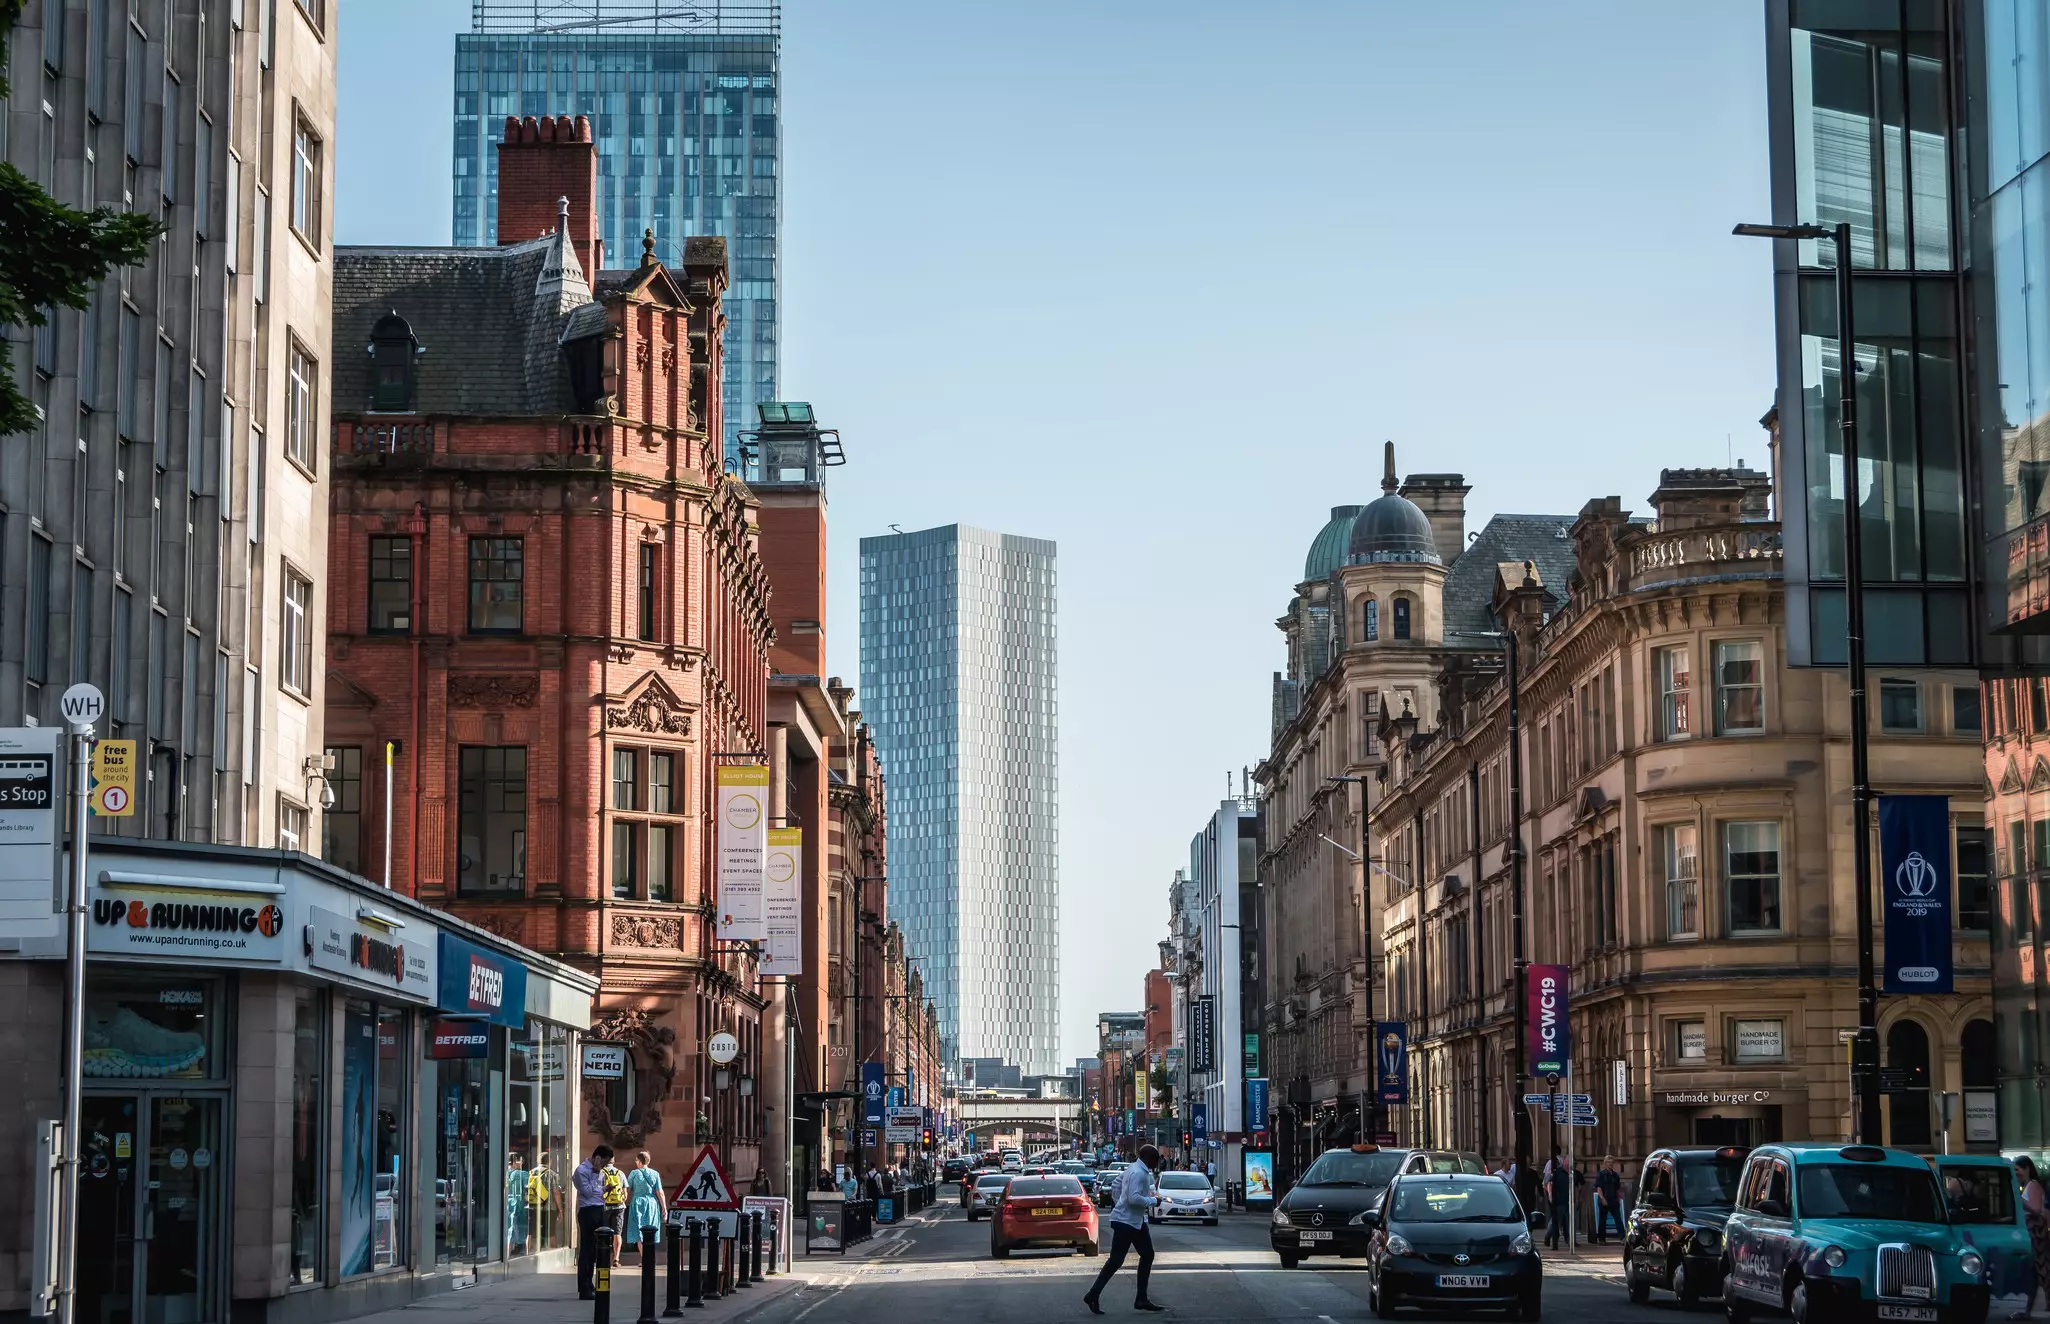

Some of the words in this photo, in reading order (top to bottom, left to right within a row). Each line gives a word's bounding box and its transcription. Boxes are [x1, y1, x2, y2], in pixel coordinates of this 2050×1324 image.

[63, 697, 101, 716] WH
[104, 745, 127, 755] free
[104, 755, 124, 765] bus
[116, 774, 129, 783] city
[12, 786, 47, 804] Stop
[111, 792, 118, 806] 1
[94, 899, 126, 927] UP
[127, 901, 149, 928] &
[151, 903, 258, 934] RUNNING
[1906, 908, 1927, 916] 2019
[129, 934, 247, 949] www.upandrunning.co.uk
[469, 963, 503, 1008] BETFRED
[1541, 977, 1557, 1052] #CWC19
[435, 1035, 487, 1045] BETFRED
[711, 1043, 737, 1051] GUSTO
[830, 1047, 848, 1057] 201
[584, 1061, 622, 1071] NERO
[1666, 1092, 1709, 1103] handmade
[1713, 1092, 1750, 1105] burger
[1441, 1276, 1467, 1286] WN06
[1469, 1276, 1488, 1286] VVW
[1881, 1306, 1910, 1318] LR57
[1914, 1307, 1934, 1319] JHY
